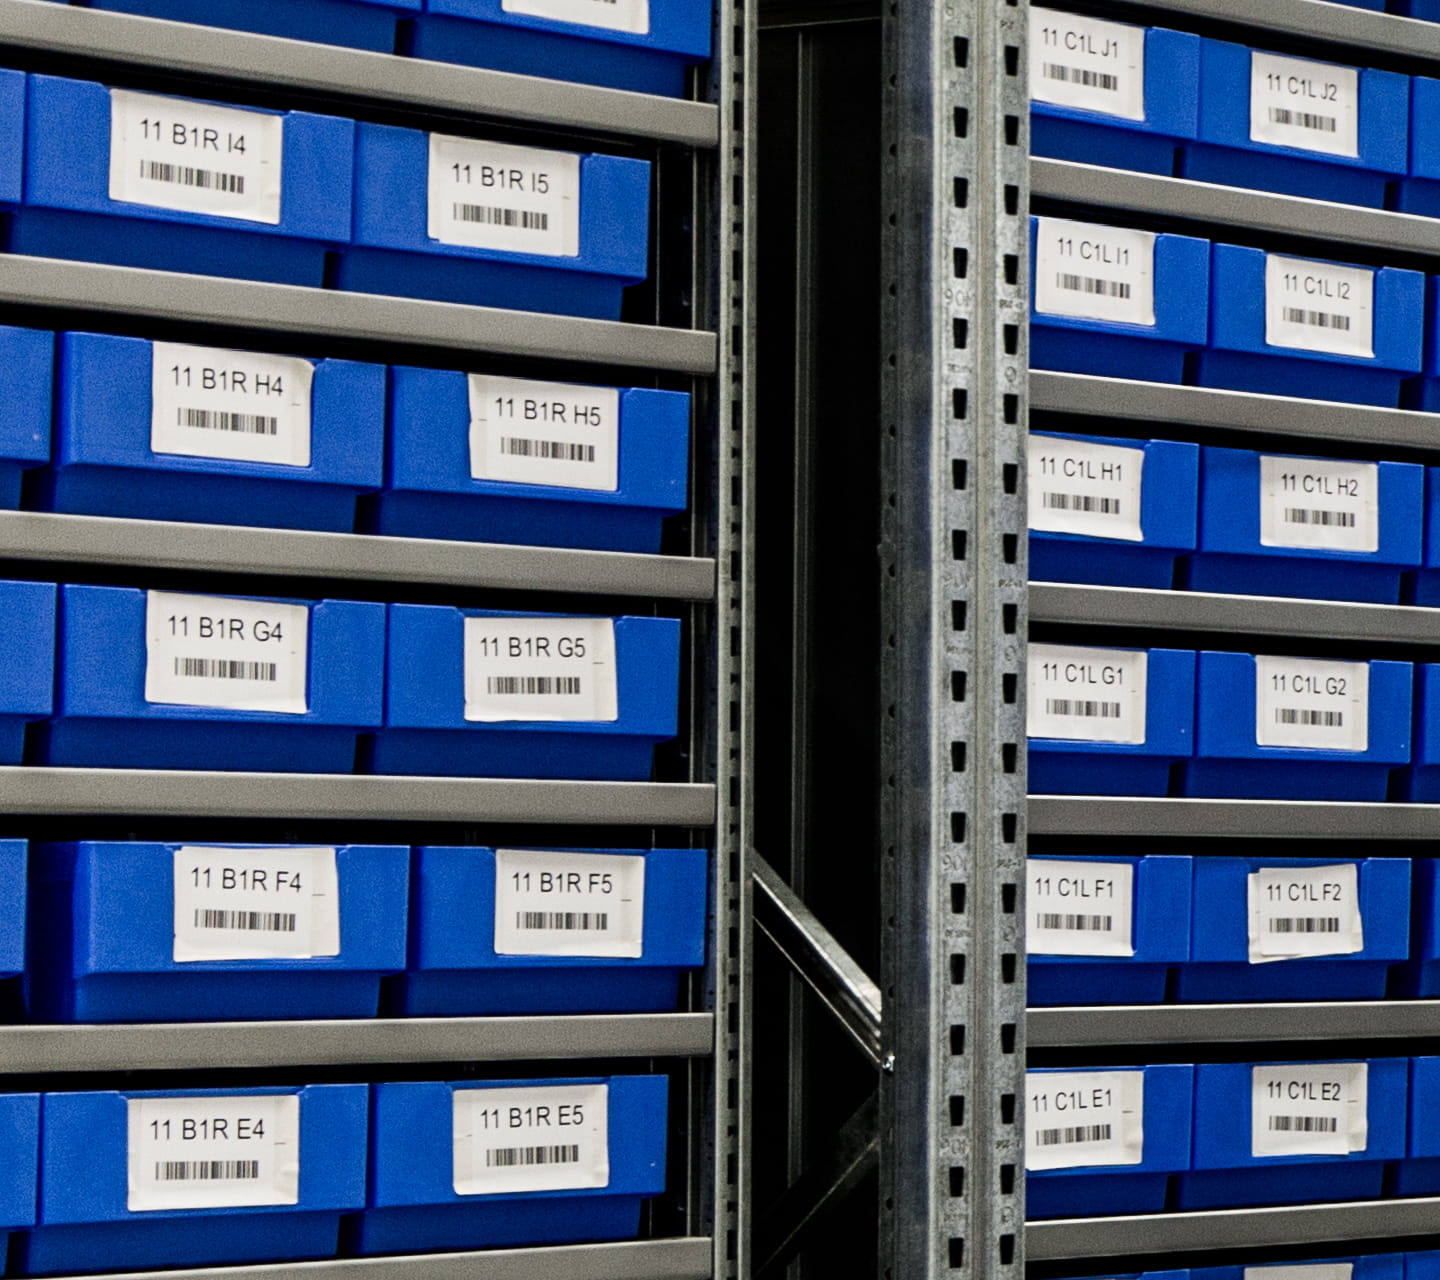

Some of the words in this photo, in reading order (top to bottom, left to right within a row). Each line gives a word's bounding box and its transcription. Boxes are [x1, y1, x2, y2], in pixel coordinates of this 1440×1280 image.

[1042, 27, 1057, 46] 11
[1064, 31, 1097, 56] C1L
[1101, 39, 1118, 58] J1
[141, 119, 160, 141] 11
[172, 123, 218, 152] B1R
[228, 133, 246, 155] I4
[495, 397, 513, 418] 11
[524, 399, 566, 424] B1R
[574, 405, 601, 428] H5
[1281, 473, 1296, 491] 11
[1302, 474, 1332, 497] C1L
[1338, 478, 1358, 498] H2
[169, 615, 188, 637] 11
[199, 616, 244, 641] B1R
[253, 620, 283, 643] G4
[1043, 663, 1057, 680] 11
[1065, 663, 1097, 685] C1L
[1102, 666, 1123, 686] G1
[513, 872, 530, 892] 11
[540, 872, 581, 894] B1R
[589, 873, 612, 895] F5
[1267, 884, 1281, 901] 11
[1288, 883, 1318, 903] C1L
[1323, 883, 1341, 902] F2
[151, 1119, 170, 1140] 11
[182, 1118, 228, 1141] B1R
[237, 1118, 265, 1141] E4
